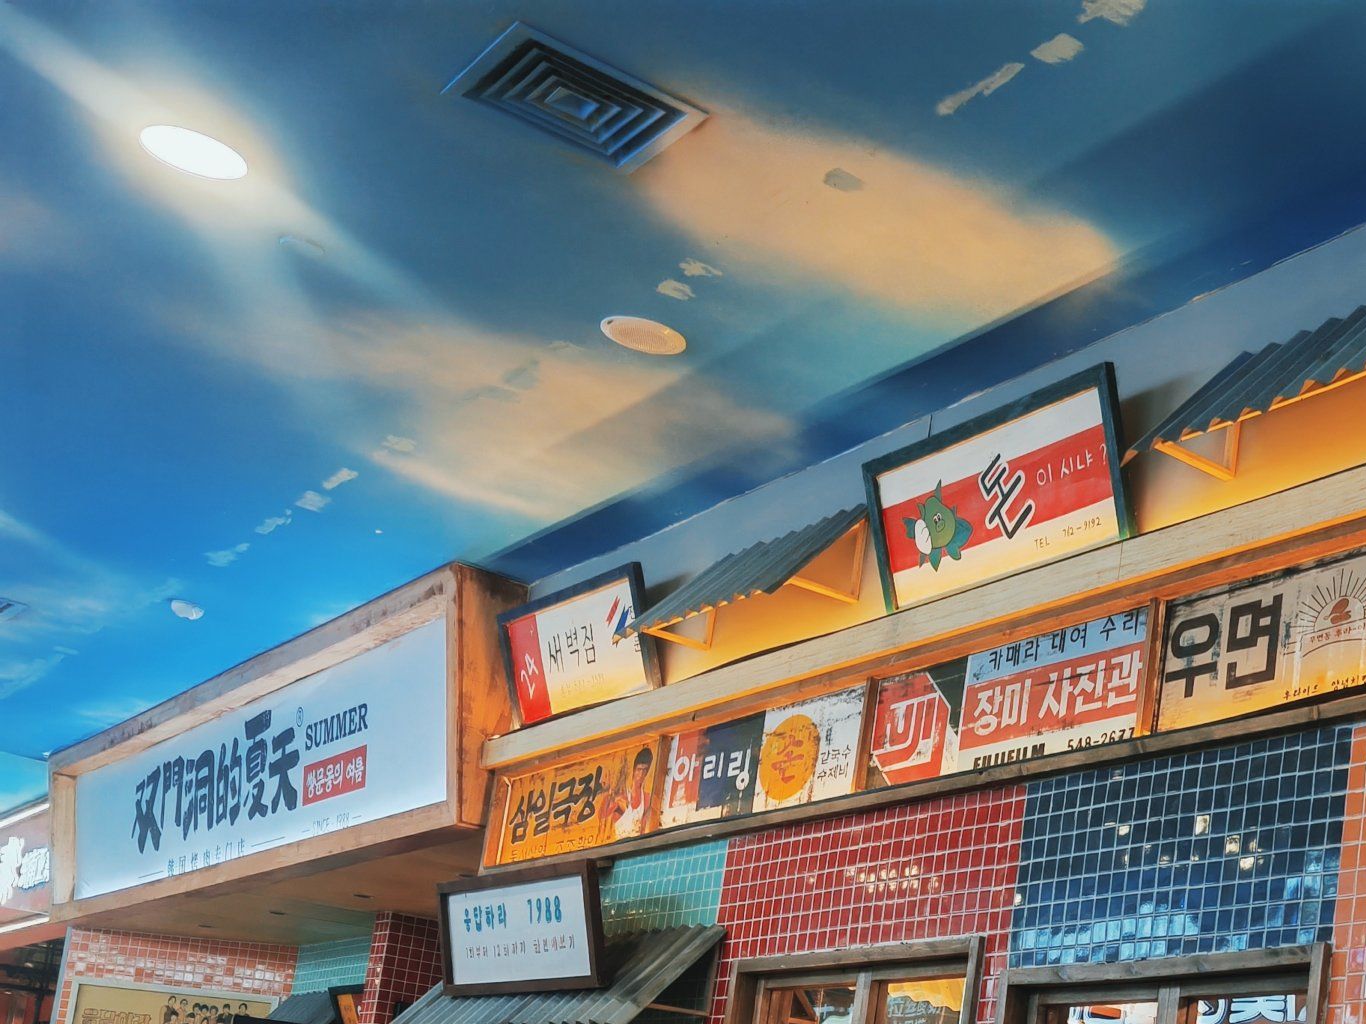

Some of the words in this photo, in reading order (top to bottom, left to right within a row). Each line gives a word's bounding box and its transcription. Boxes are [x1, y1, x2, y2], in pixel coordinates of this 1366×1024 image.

[1034, 536, 1050, 550] TEL
[988, 641, 1041, 671] 카메라
[1051, 622, 1088, 653] 대여
[1100, 610, 1140, 642] 수리
[1165, 593, 1283, 699] 우면
[973, 678, 1032, 736] 장미
[1038, 650, 1143, 721] 사진관
[305, 703, 368, 751] SUMMER
[509, 765, 604, 845] 삼일극장
[463, 903, 507, 933] 응답하라
[527, 895, 562, 925] 1988
